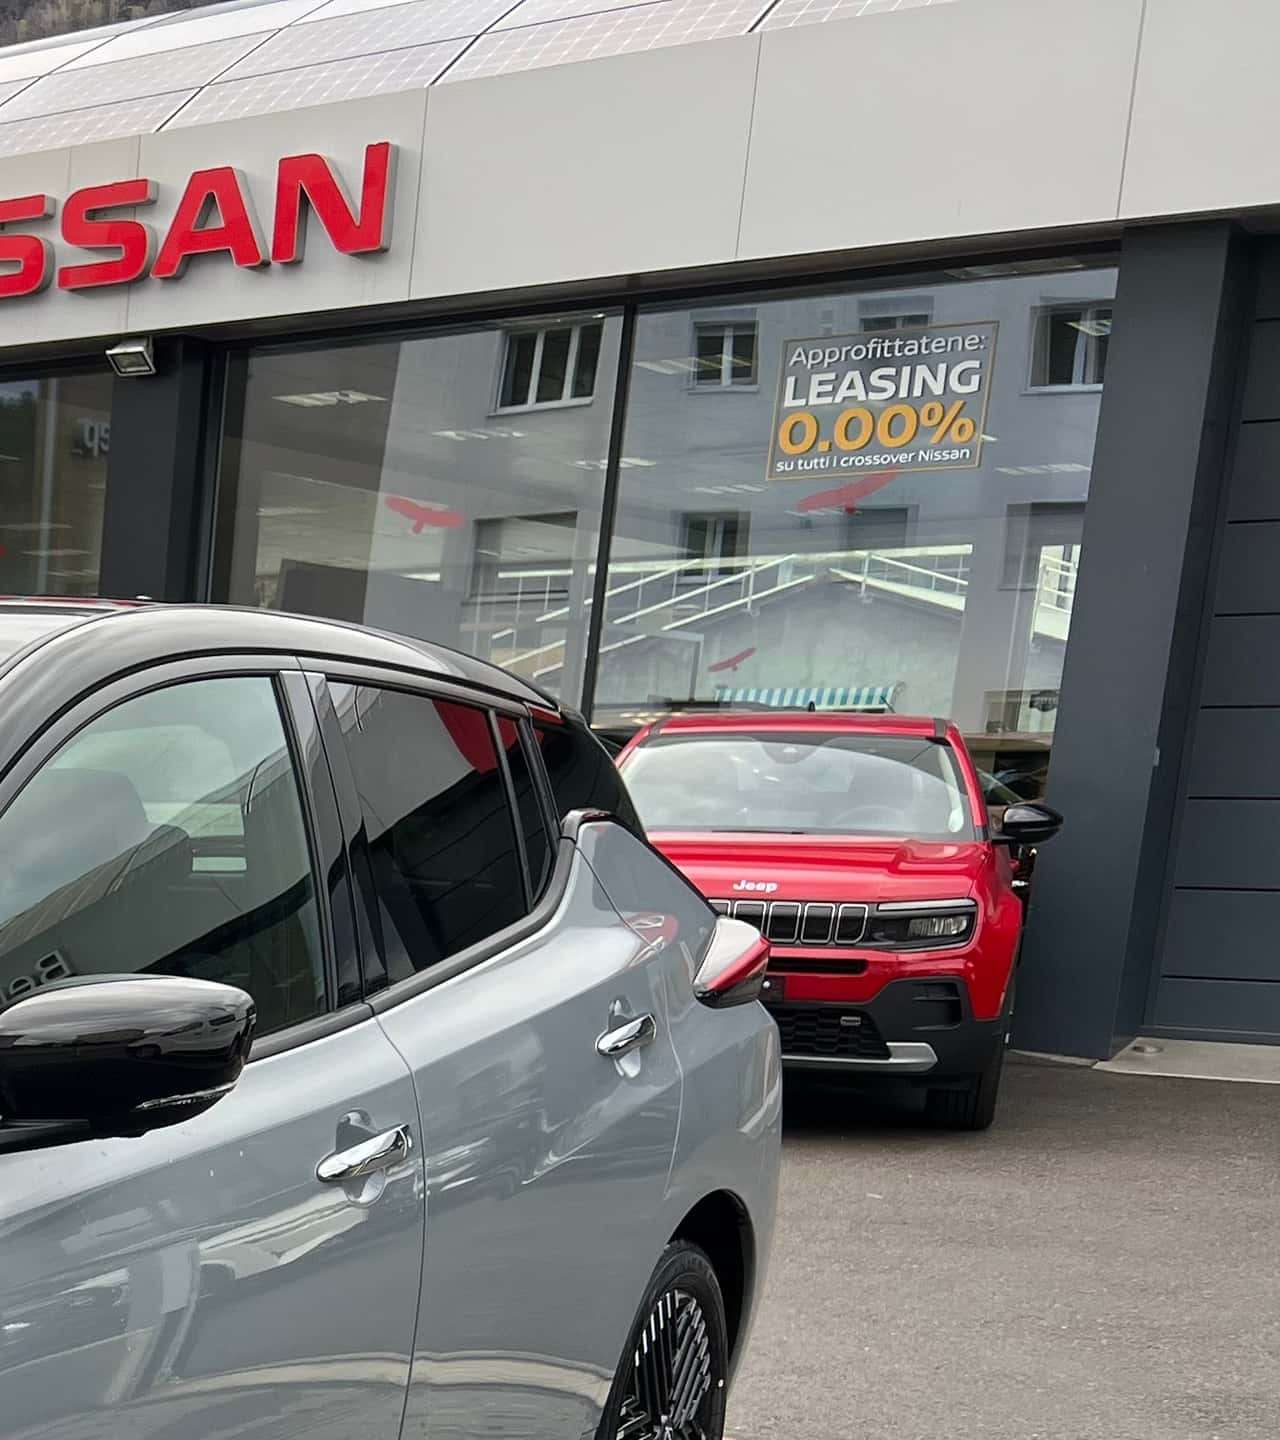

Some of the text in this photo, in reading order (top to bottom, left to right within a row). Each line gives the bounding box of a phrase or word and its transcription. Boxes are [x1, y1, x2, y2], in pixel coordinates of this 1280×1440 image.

[788, 334, 988, 370] Approfittatene:
[784, 360, 981, 408] LEASING
[778, 400, 976, 455] 0.00%
[775, 458, 795, 472] su
[797, 455, 830, 470] tutti
[839, 453, 916, 468] crossover
[918, 448, 970, 463] Nissan
[732, 879, 778, 893] Jeep
